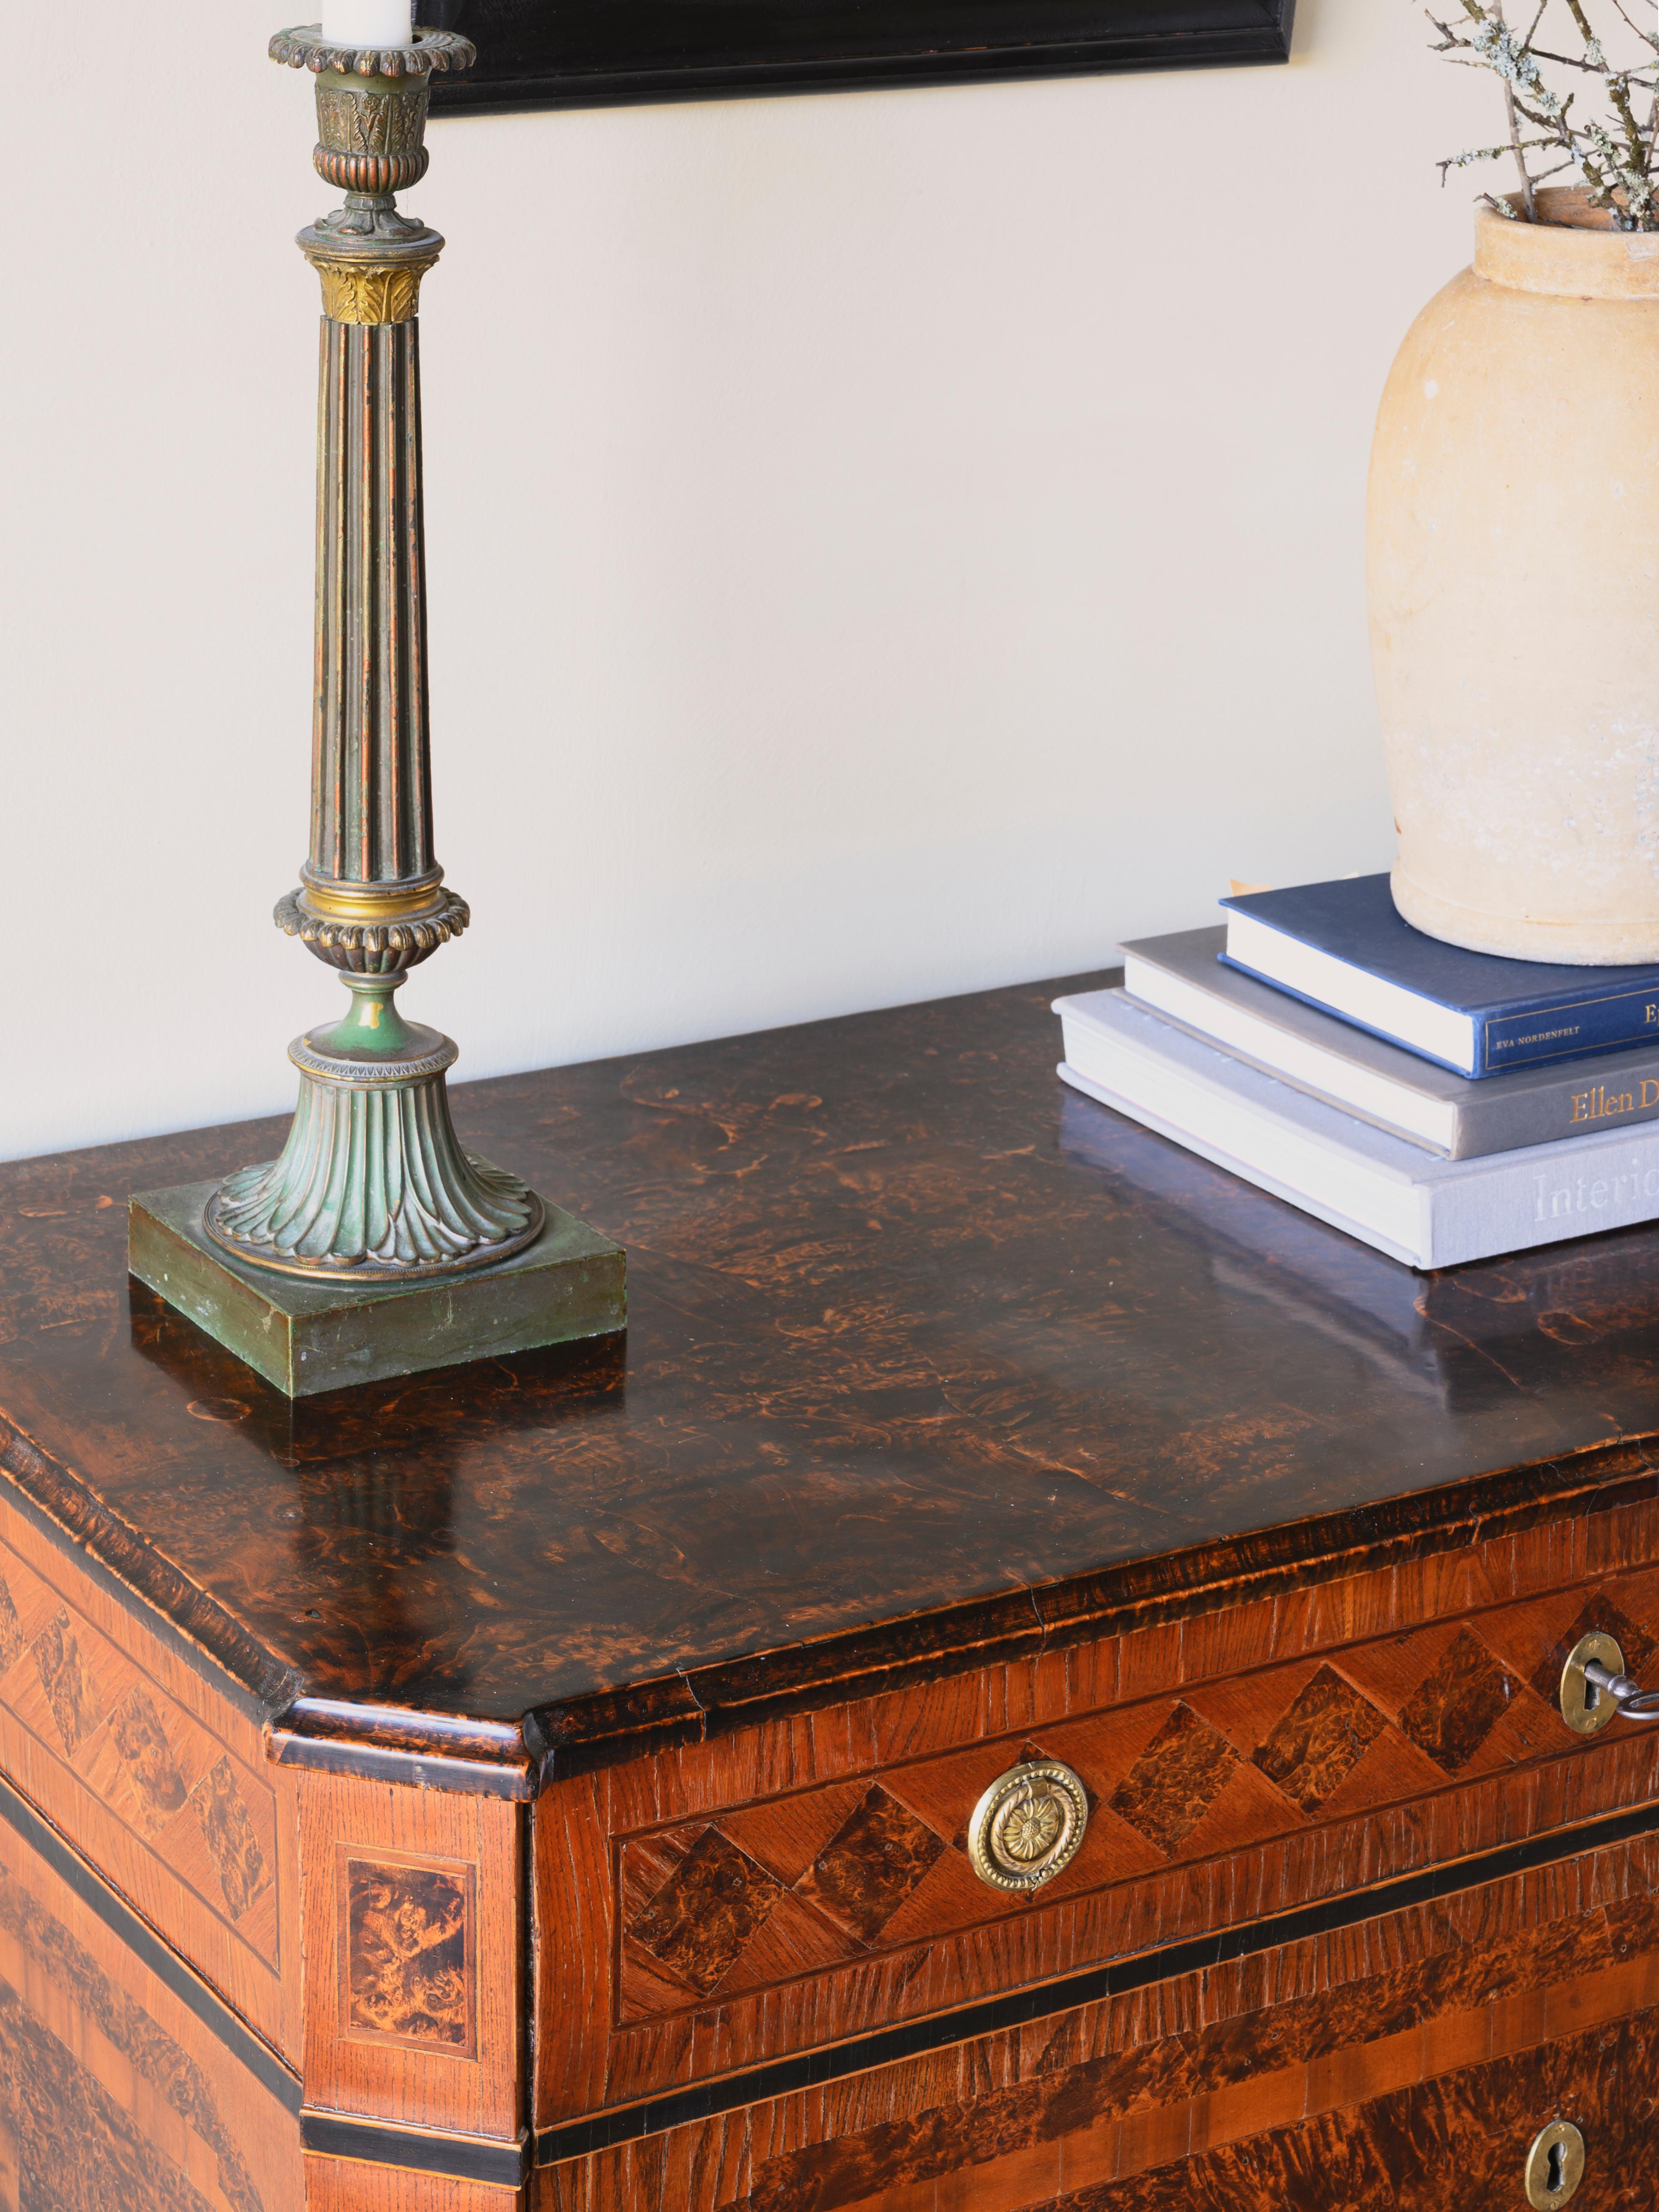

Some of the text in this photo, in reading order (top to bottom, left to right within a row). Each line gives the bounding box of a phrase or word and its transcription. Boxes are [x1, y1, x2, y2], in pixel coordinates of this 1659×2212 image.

[1496, 1004, 1659, 1049] EVA NORDENFELT E
[1570, 1086, 1634, 1123] Ellen
[1533, 1158, 1659, 1222] Interio
